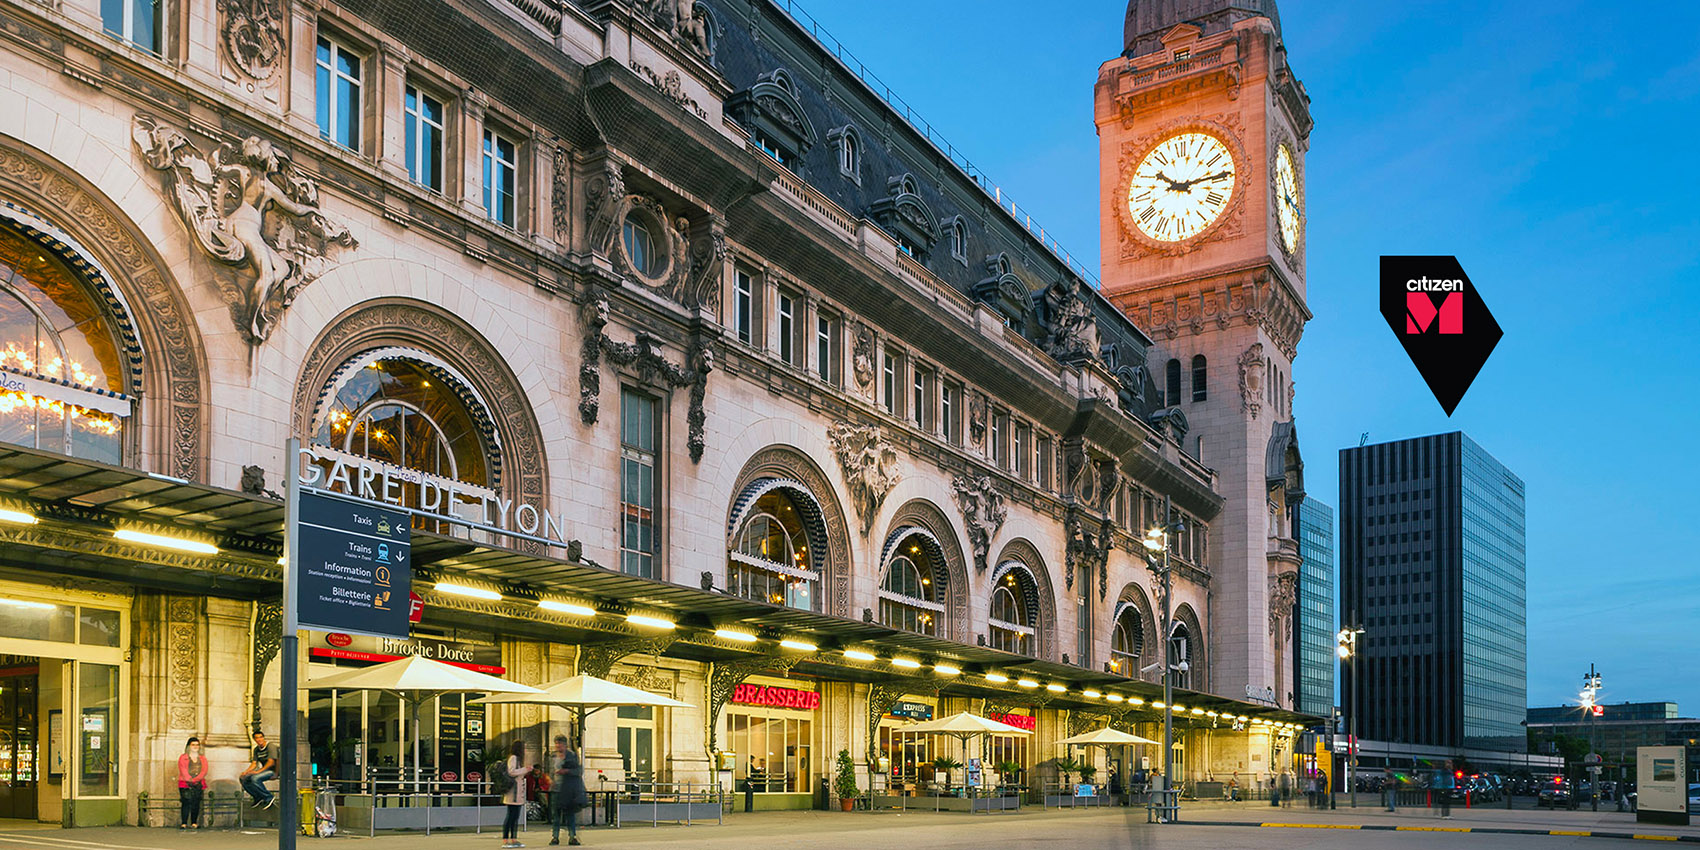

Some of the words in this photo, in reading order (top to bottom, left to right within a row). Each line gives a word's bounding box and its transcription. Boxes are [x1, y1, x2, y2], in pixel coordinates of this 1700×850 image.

[299, 448, 399, 503] GARE
[421, 478, 464, 518] DE
[482, 494, 565, 543] LYON
[353, 514, 372, 526] Taxis
[349, 542, 372, 554] Trains
[324, 561, 371, 577] Information
[324, 572, 343, 580] reception
[332, 586, 371, 600] Billetterie
[383, 638, 433, 657] Brioche
[438, 644, 473, 662] Dorée
[732, 684, 820, 710] BRASSERIE
